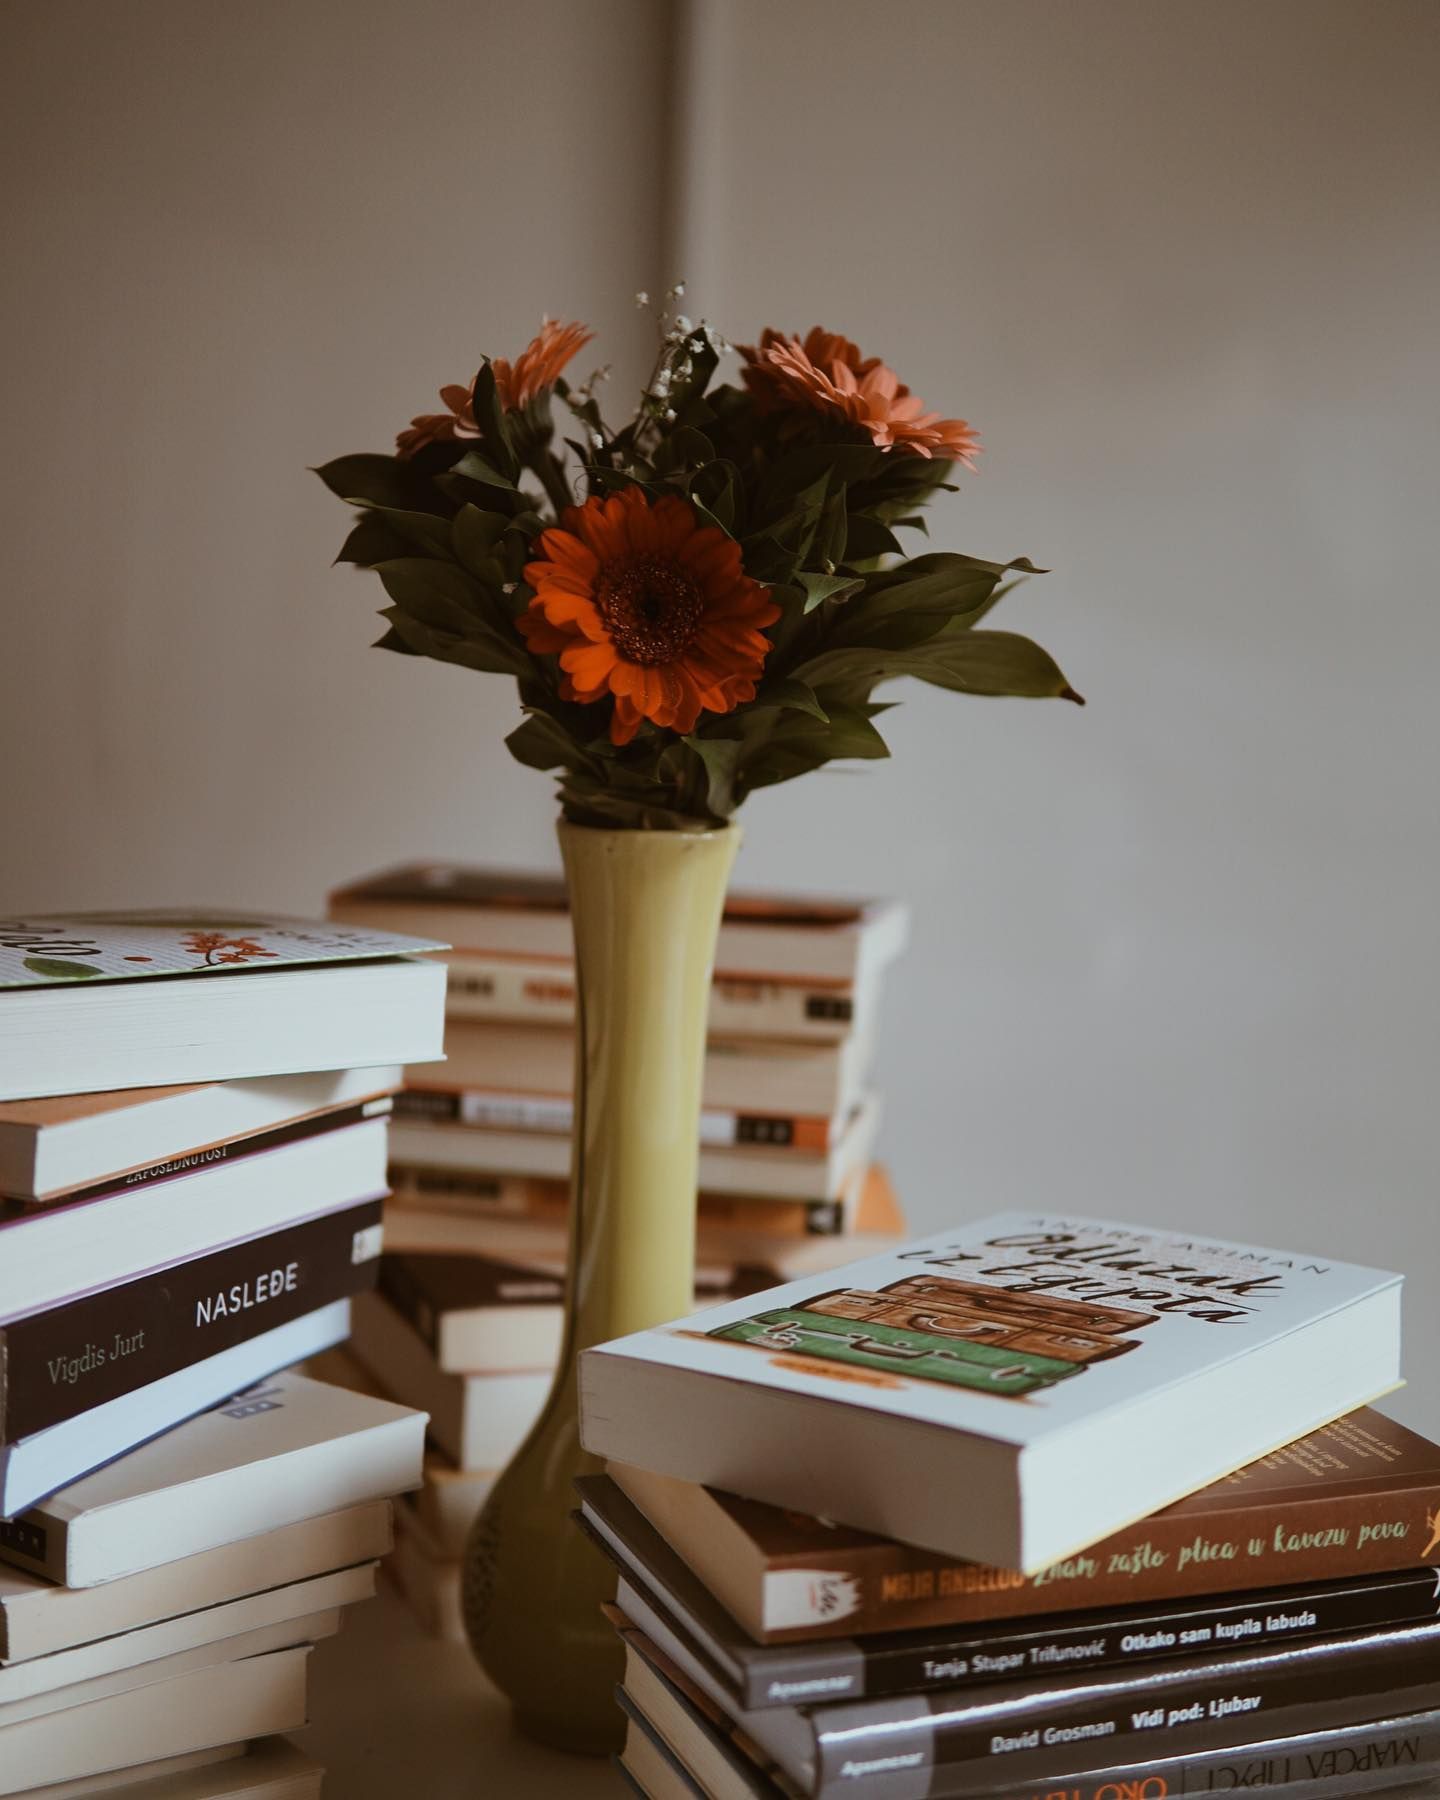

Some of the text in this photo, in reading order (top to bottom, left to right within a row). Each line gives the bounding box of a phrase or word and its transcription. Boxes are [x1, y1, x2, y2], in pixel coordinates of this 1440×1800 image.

[985, 1233, 1285, 1297] Odlazak
[1170, 1243, 1330, 1274] ASIMAN
[196, 1262, 299, 1328] NASLEĐE
[979, 1260, 1261, 1324] Egipta
[48, 1343, 105, 1384] Vigdis
[110, 1330, 145, 1360] Jurt
[1108, 1542, 1168, 1574] zašto
[1177, 1536, 1238, 1571] ptica
[1248, 1539, 1265, 1556] u
[1273, 1525, 1349, 1552] kavezu
[1357, 1521, 1409, 1549] peva
[922, 1657, 966, 1679] Tanja
[972, 1651, 1024, 1675] Stupar
[1120, 1633, 1175, 1653] Otkako
[1179, 1628, 1212, 1646] sam
[1216, 1619, 1261, 1643] kupila
[1266, 1610, 1317, 1634] labuda
[991, 1695, 1262, 1754] David Grosman Vidi pod: Ljubav
